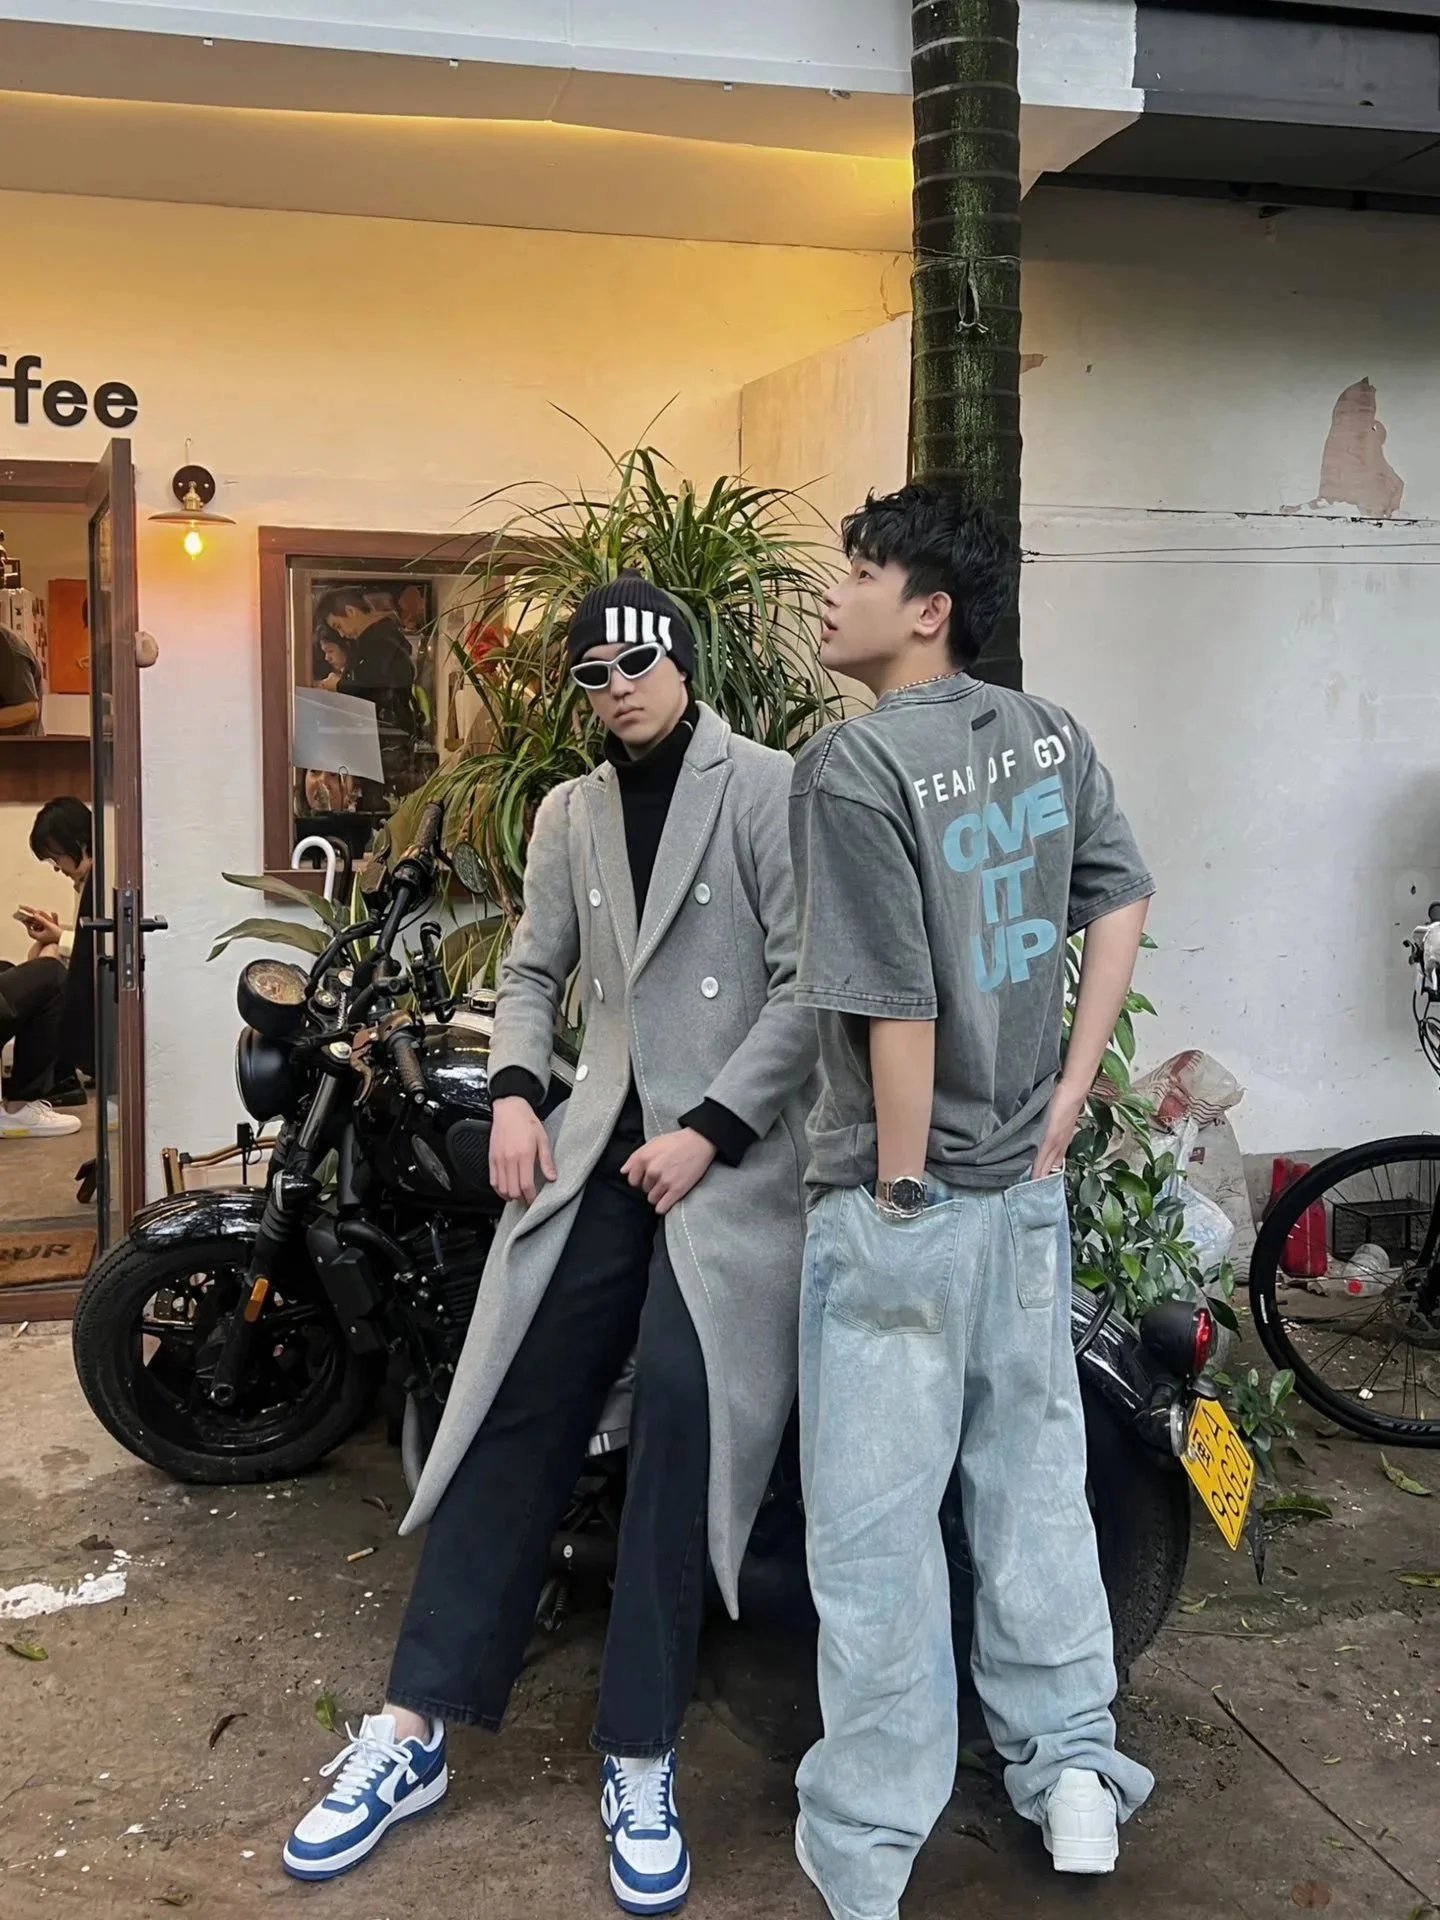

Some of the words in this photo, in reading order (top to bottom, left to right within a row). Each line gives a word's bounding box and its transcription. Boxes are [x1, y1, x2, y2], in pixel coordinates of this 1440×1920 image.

[913, 765, 976, 808] FEAR
[1033, 725, 1072, 769] GO
[982, 856, 1034, 924] IT
[972, 918, 1057, 993] UP
[1211, 1430, 1251, 1536] 96G20
